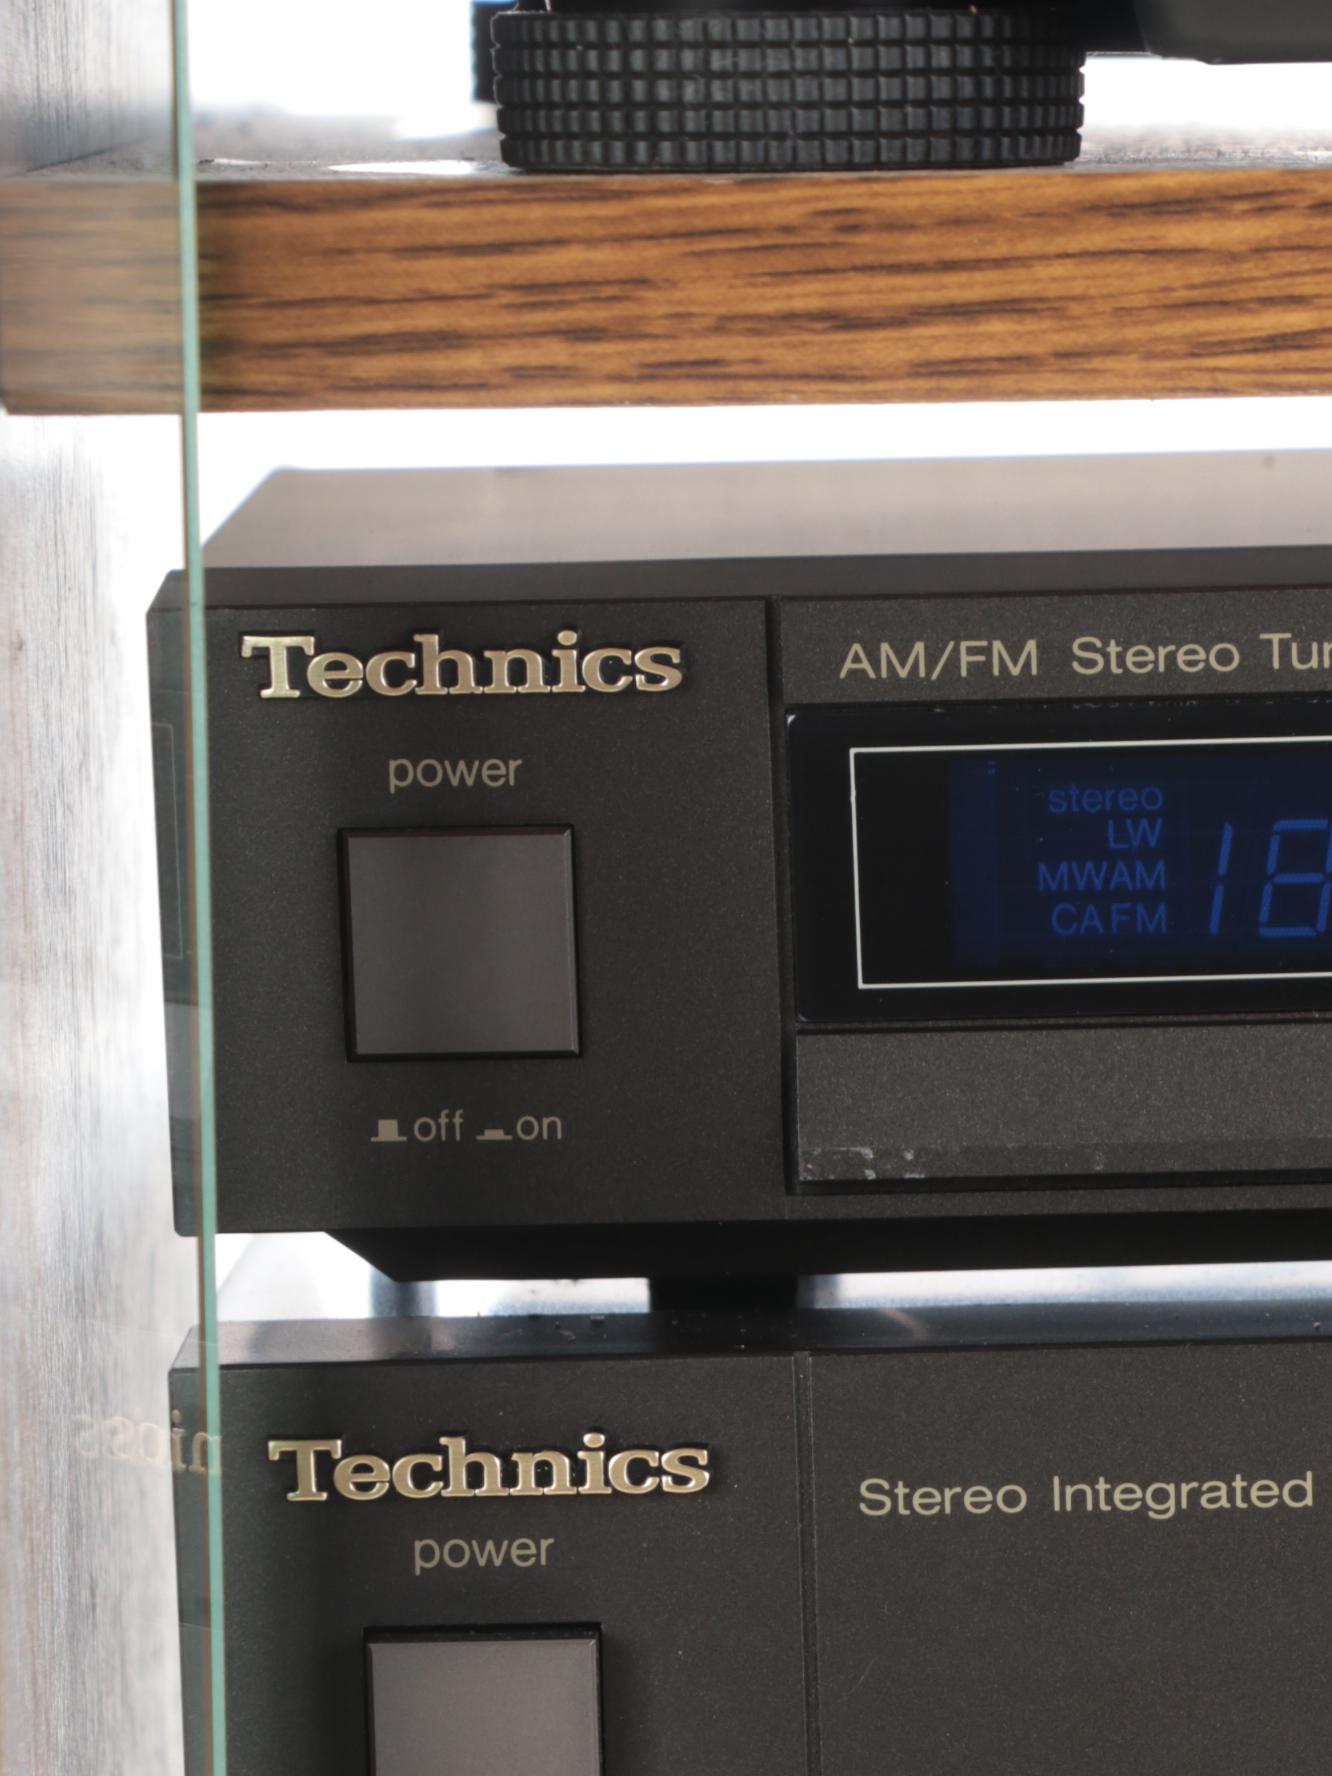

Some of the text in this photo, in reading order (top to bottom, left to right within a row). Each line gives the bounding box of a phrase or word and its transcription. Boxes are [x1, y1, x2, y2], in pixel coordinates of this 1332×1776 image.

[241, 630, 682, 699] Technics
[839, 639, 1038, 681] AM/FM
[1071, 636, 1240, 675] Stereo
[388, 758, 523, 794] power
[1045, 780, 1166, 816] stereo
[1104, 815, 1164, 852] LW
[413, 1109, 563, 1143] off on
[267, 1432, 711, 1501] Technics
[859, 1477, 1028, 1516] Stereo
[1052, 1470, 1313, 1520] Integrated
[414, 1537, 555, 1576] power
